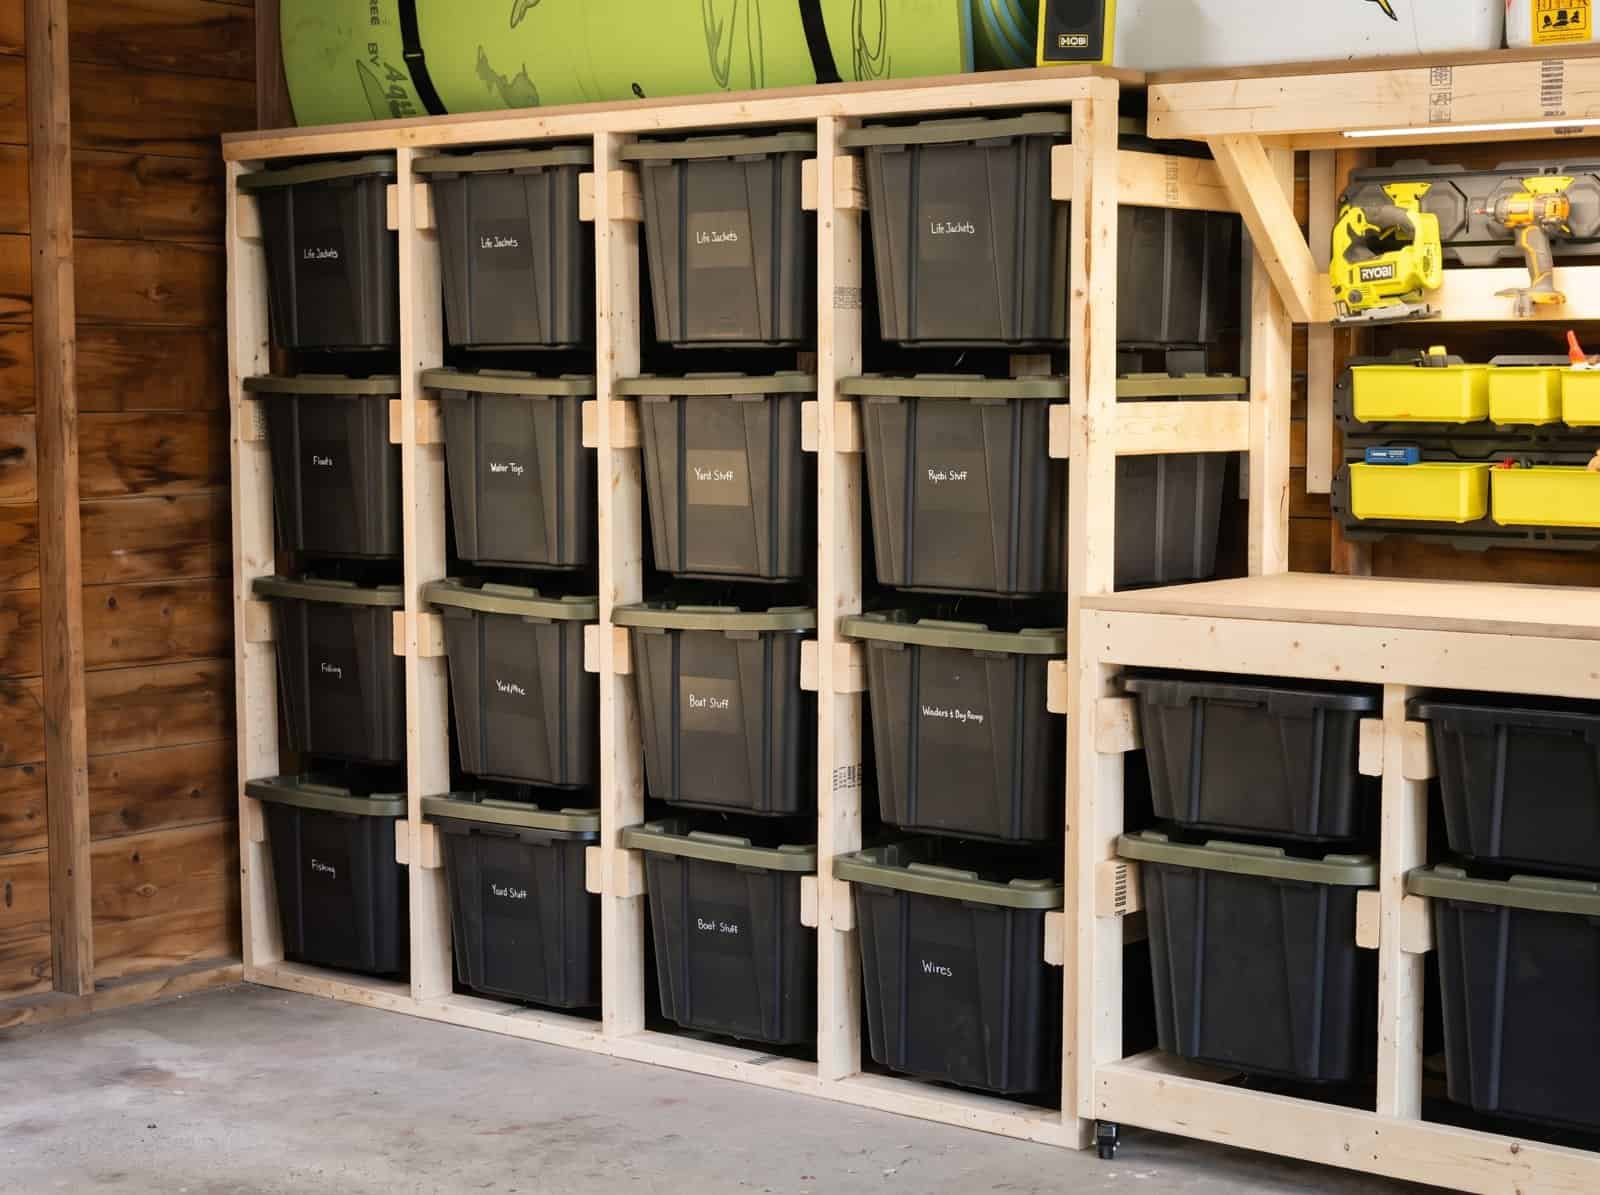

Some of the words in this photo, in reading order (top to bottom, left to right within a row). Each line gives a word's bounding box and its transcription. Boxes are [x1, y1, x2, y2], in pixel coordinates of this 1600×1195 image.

[931, 221, 944, 234] Life
[945, 220, 975, 235] Jackets
[480, 236, 493, 249] Life
[696, 231, 710, 245] Life
[1360, 265, 1392, 280] RYOBI
[490, 462, 508, 473] Water
[693, 467, 712, 481] Yard
[713, 471, 735, 481] Stuff
[928, 469, 947, 485] Ryobi
[949, 470, 968, 481] Stuff
[689, 694, 706, 708] Boat
[709, 697, 729, 710] Stuff
[491, 883, 508, 897] Yard
[509, 887, 528, 900] Stuff
[697, 918, 716, 931] Boat
[719, 921, 738, 935] Stuff
[921, 959, 953, 977] Wires
